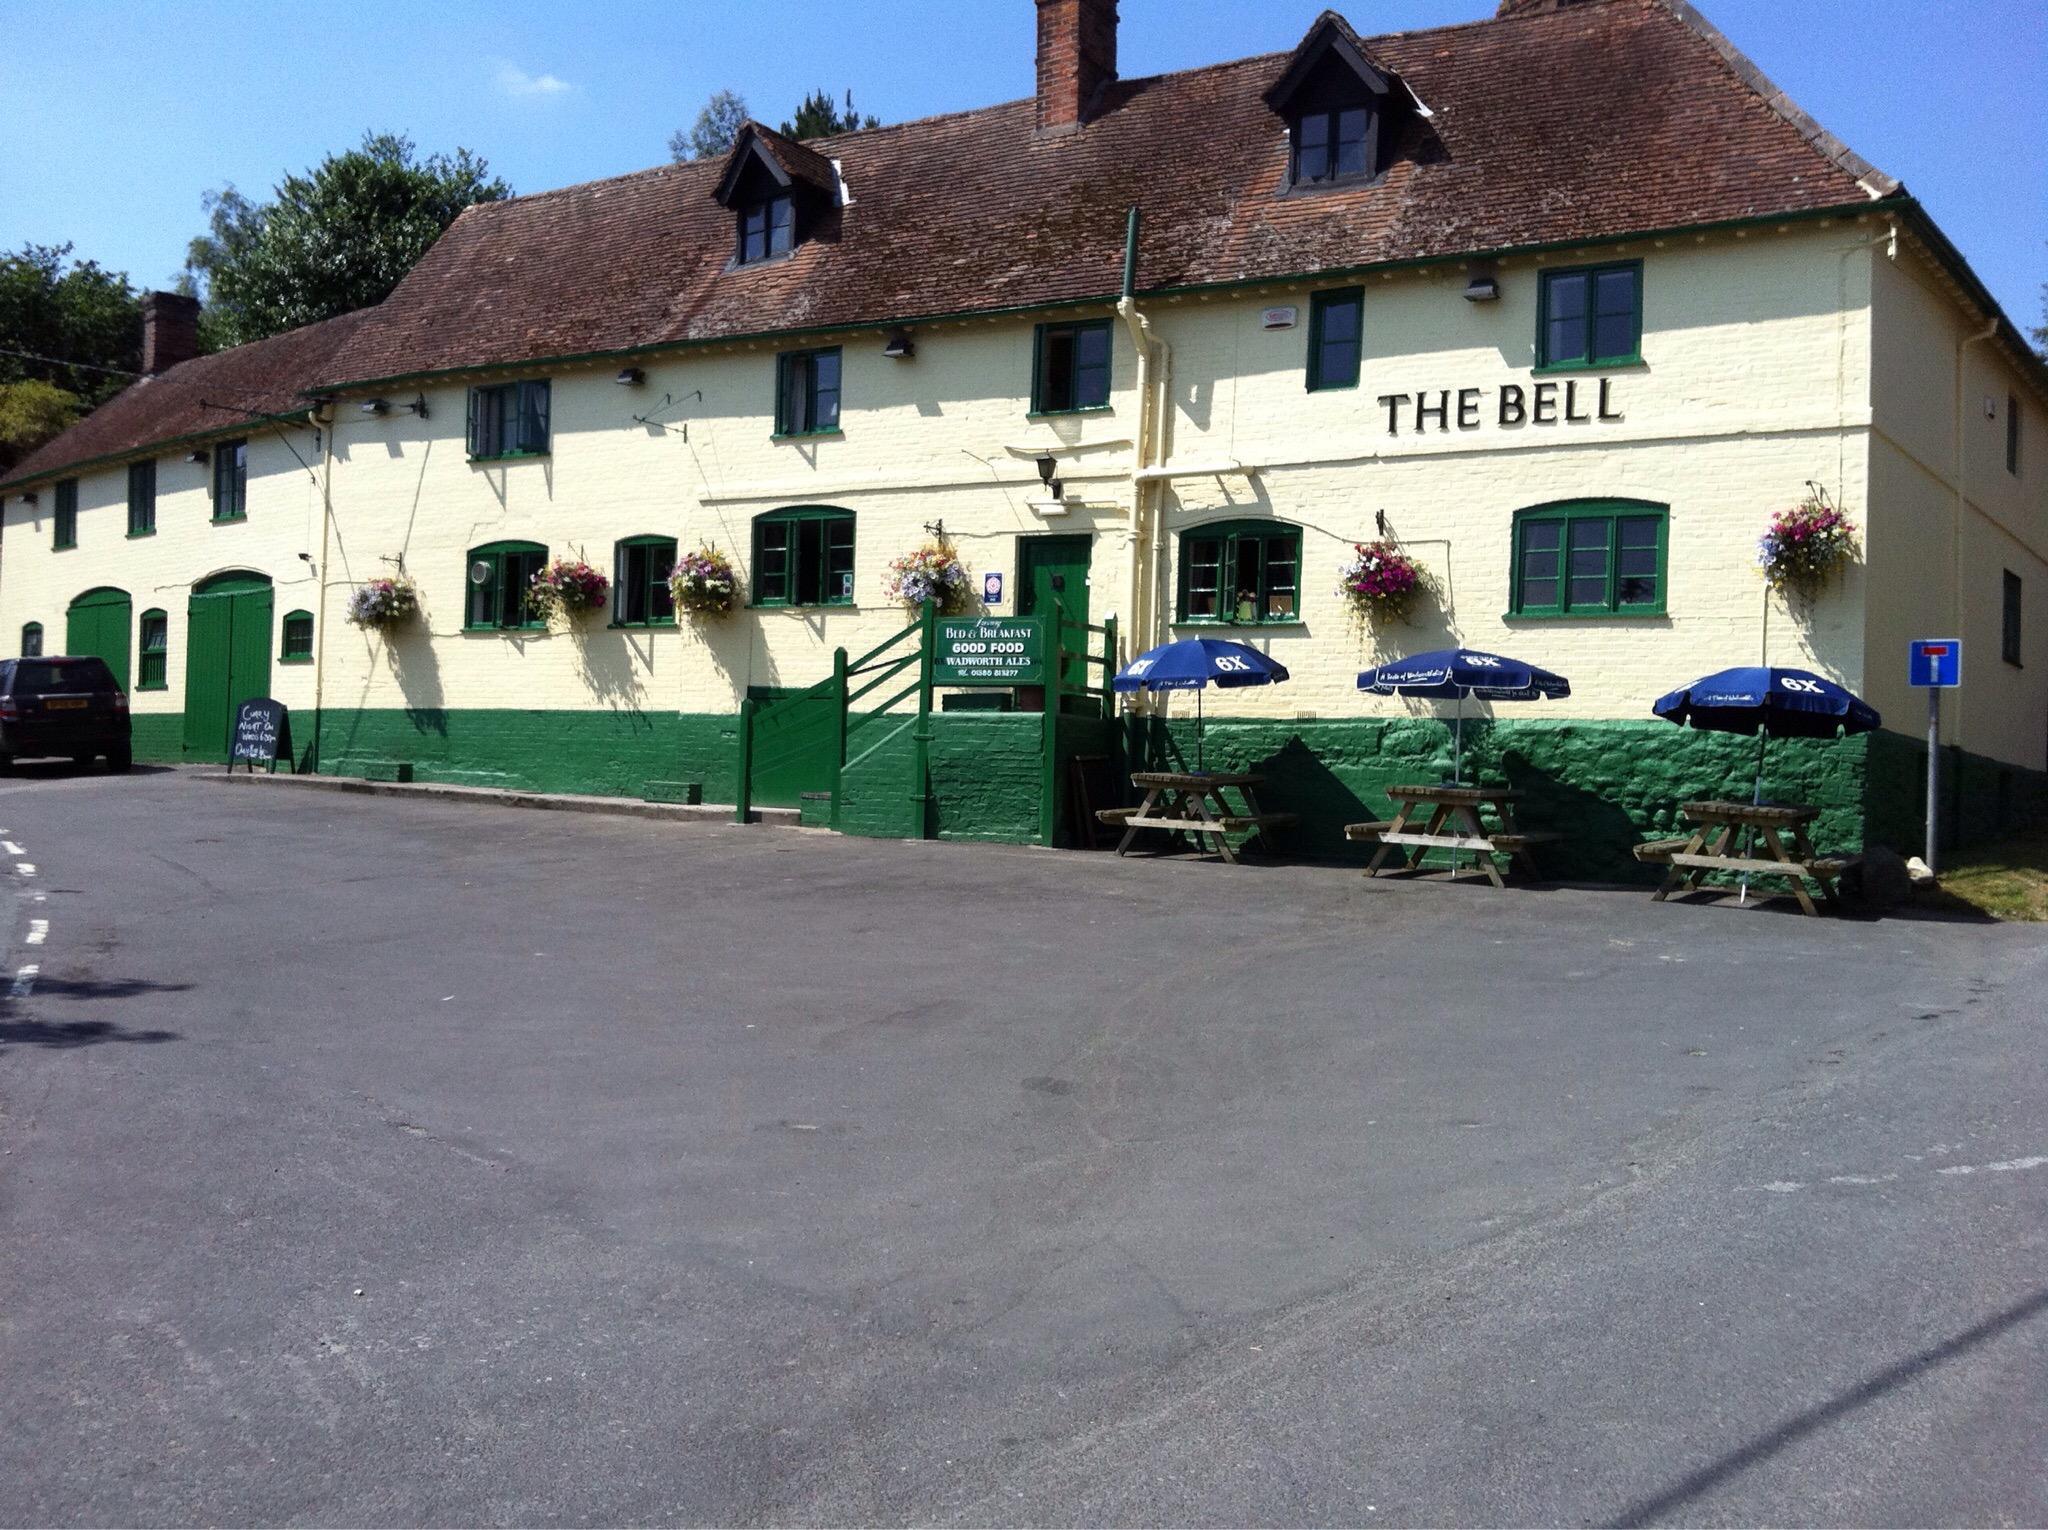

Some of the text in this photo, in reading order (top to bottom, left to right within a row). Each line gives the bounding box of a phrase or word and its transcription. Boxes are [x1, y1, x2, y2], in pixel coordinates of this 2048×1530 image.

[1377, 378, 1623, 434] THE BELL
[968, 629, 977, 639] &
[952, 642, 1025, 653] GOOD FOOD
[946, 656, 1031, 666] WADWORTH ALES
[1215, 655, 1251, 672] 6X
[1781, 677, 1825, 693] 6X
